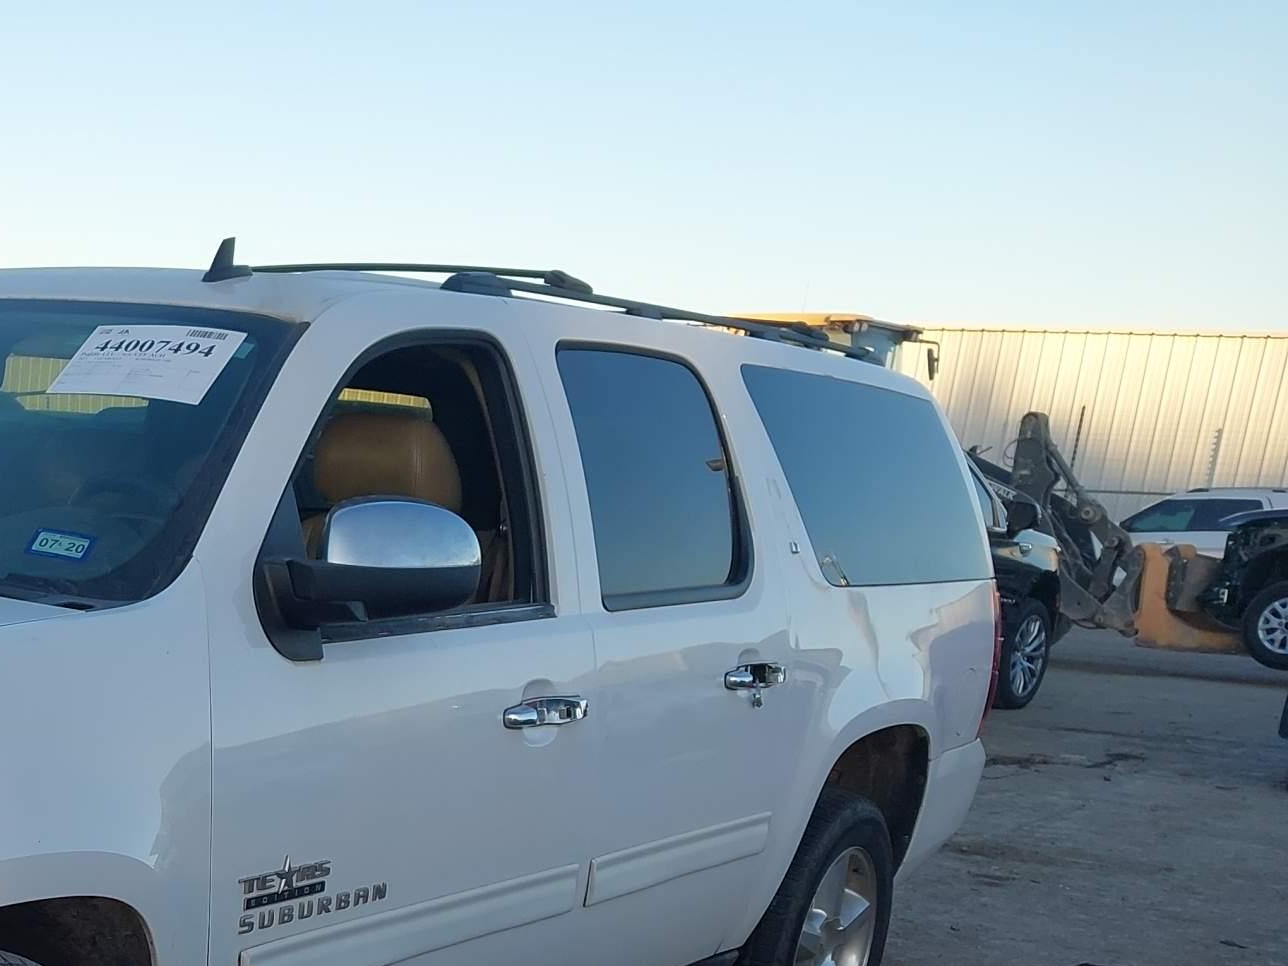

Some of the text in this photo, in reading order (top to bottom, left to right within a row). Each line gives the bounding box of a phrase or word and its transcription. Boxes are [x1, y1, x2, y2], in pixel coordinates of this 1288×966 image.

[95, 339, 217, 358] 44007494
[238, 855, 331, 894] TEXAS
[238, 882, 388, 935] SUBURBAN
[250, 882, 323, 907] EDITION
